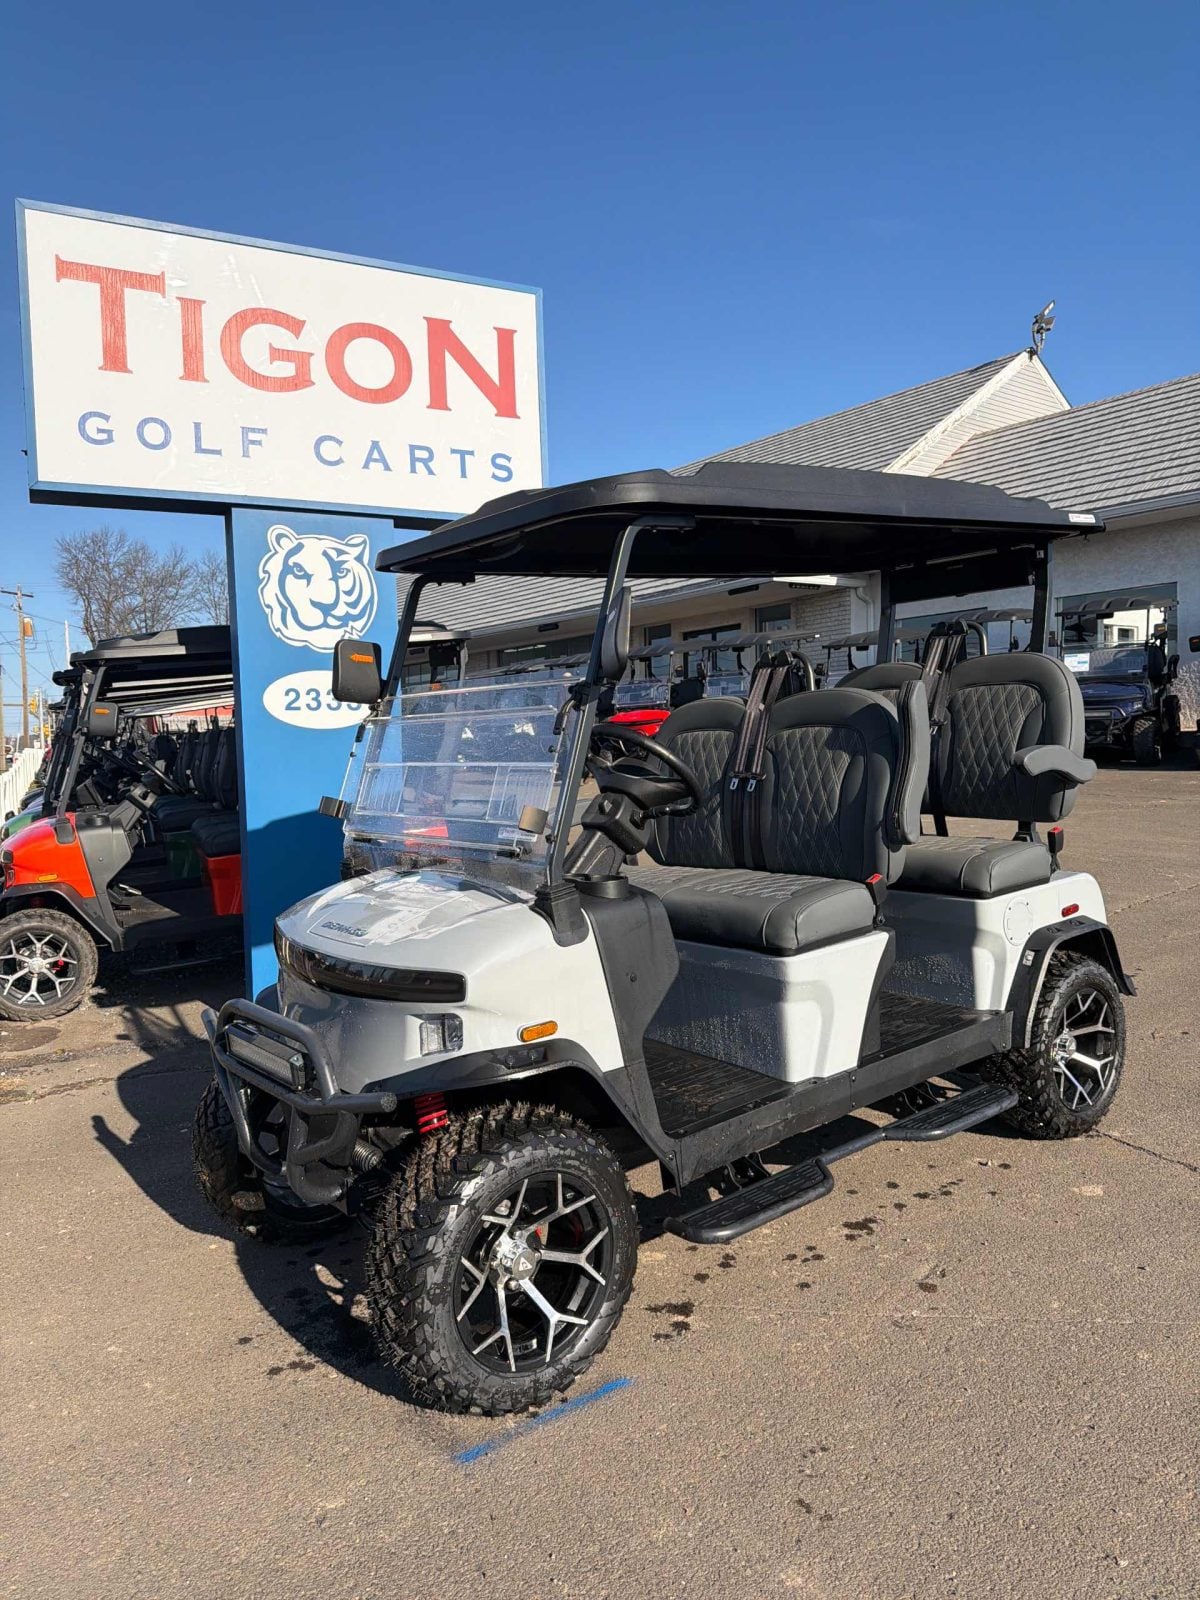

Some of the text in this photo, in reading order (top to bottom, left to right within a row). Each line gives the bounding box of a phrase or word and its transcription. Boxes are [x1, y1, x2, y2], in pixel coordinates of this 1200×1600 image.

[55, 255, 520, 420] TIGON
[78, 410, 515, 483] GOLF CARTS
[284, 687, 362, 712] 233
